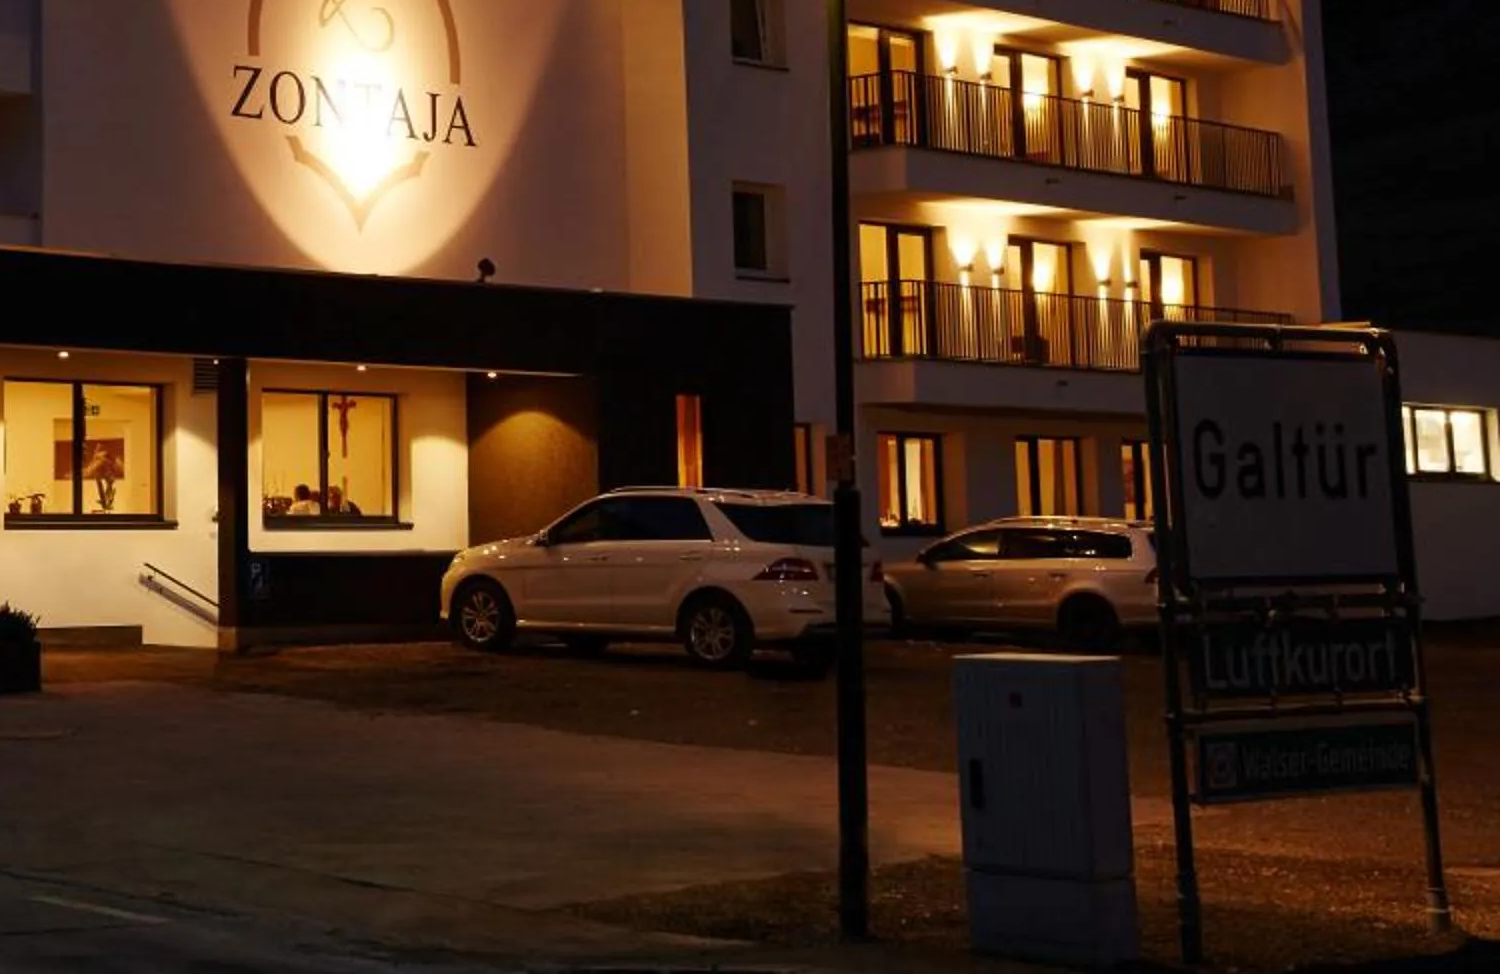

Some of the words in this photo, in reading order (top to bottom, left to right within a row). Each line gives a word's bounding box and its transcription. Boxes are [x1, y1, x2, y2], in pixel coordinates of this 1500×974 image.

[230, 64, 478, 148] ZONTAJA
[1194, 418, 1377, 499] Galtür
[1202, 629, 1396, 689] Luftkurort
[1240, 735, 1411, 779] Walser-Gemeinde
